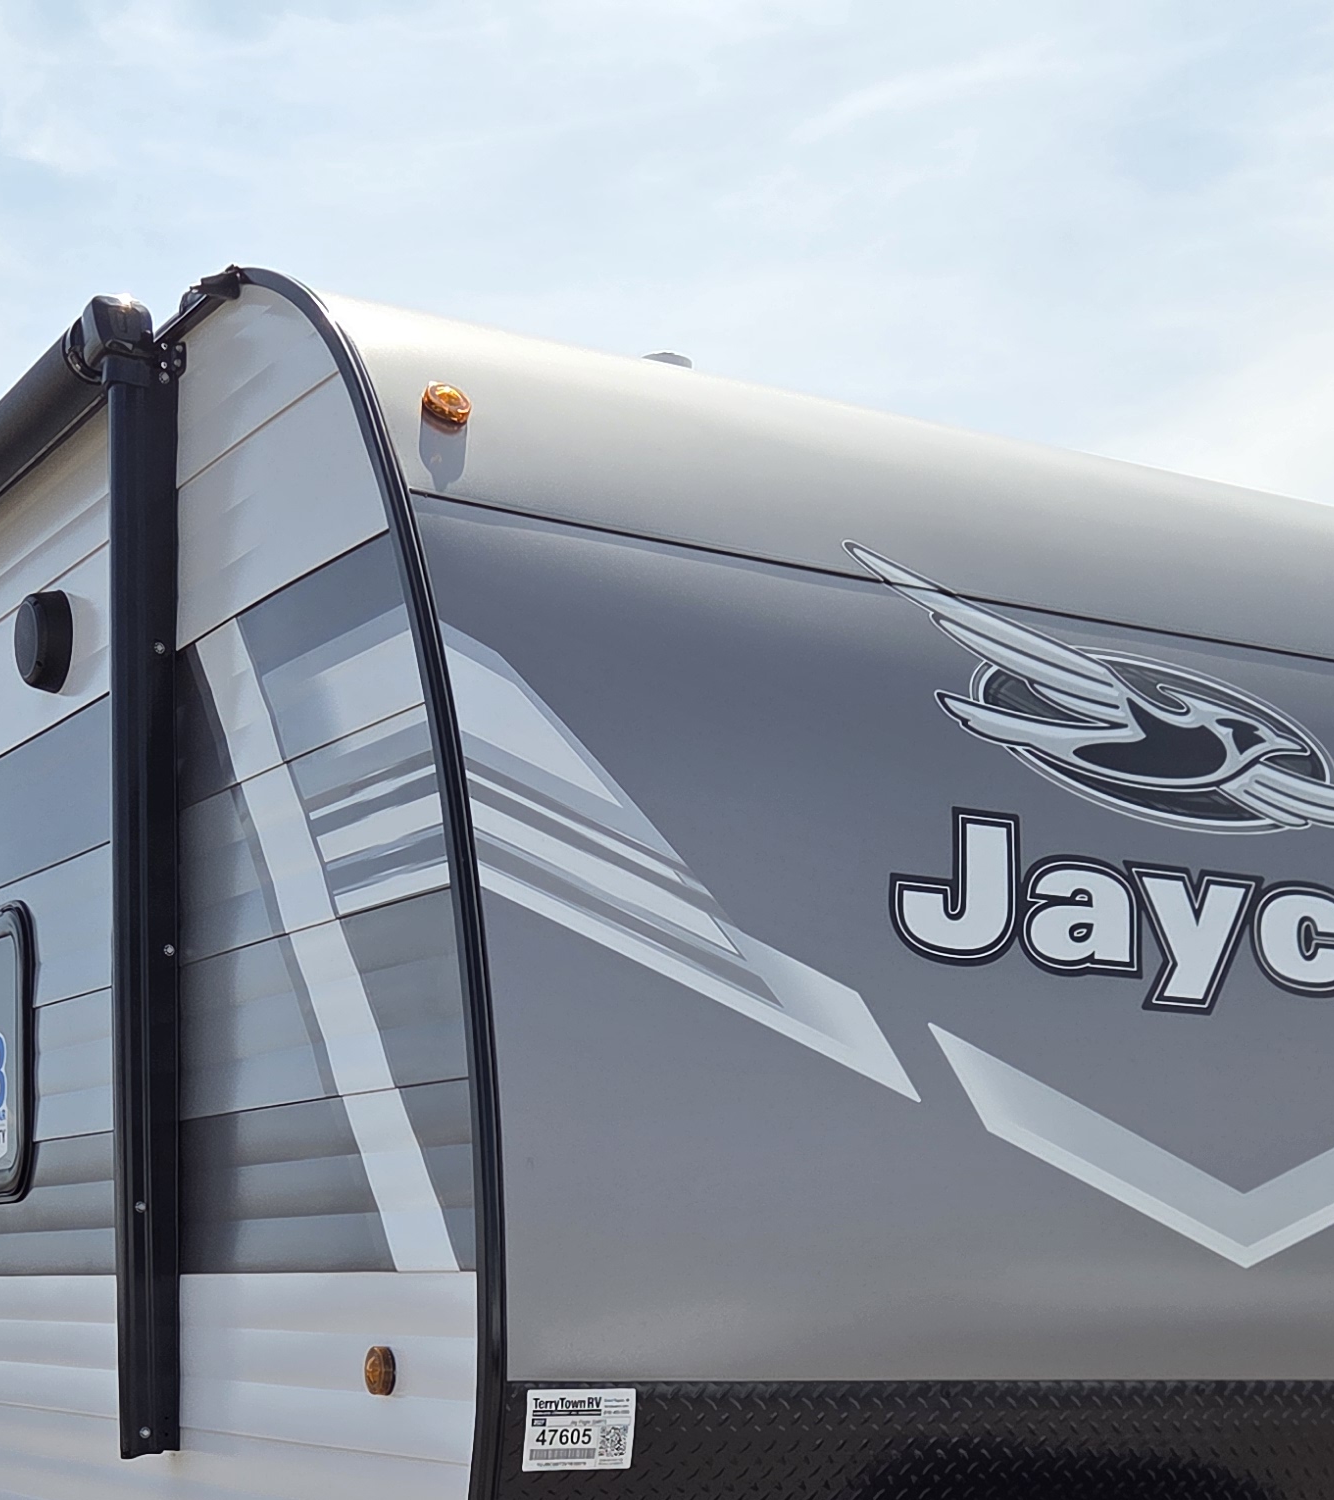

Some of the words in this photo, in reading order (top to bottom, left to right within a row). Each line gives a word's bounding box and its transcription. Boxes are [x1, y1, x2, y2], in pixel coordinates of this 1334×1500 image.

[532, 1397, 586, 1411] TerryTown
[587, 1396, 602, 1409] RV
[535, 1428, 592, 1446] 47605
